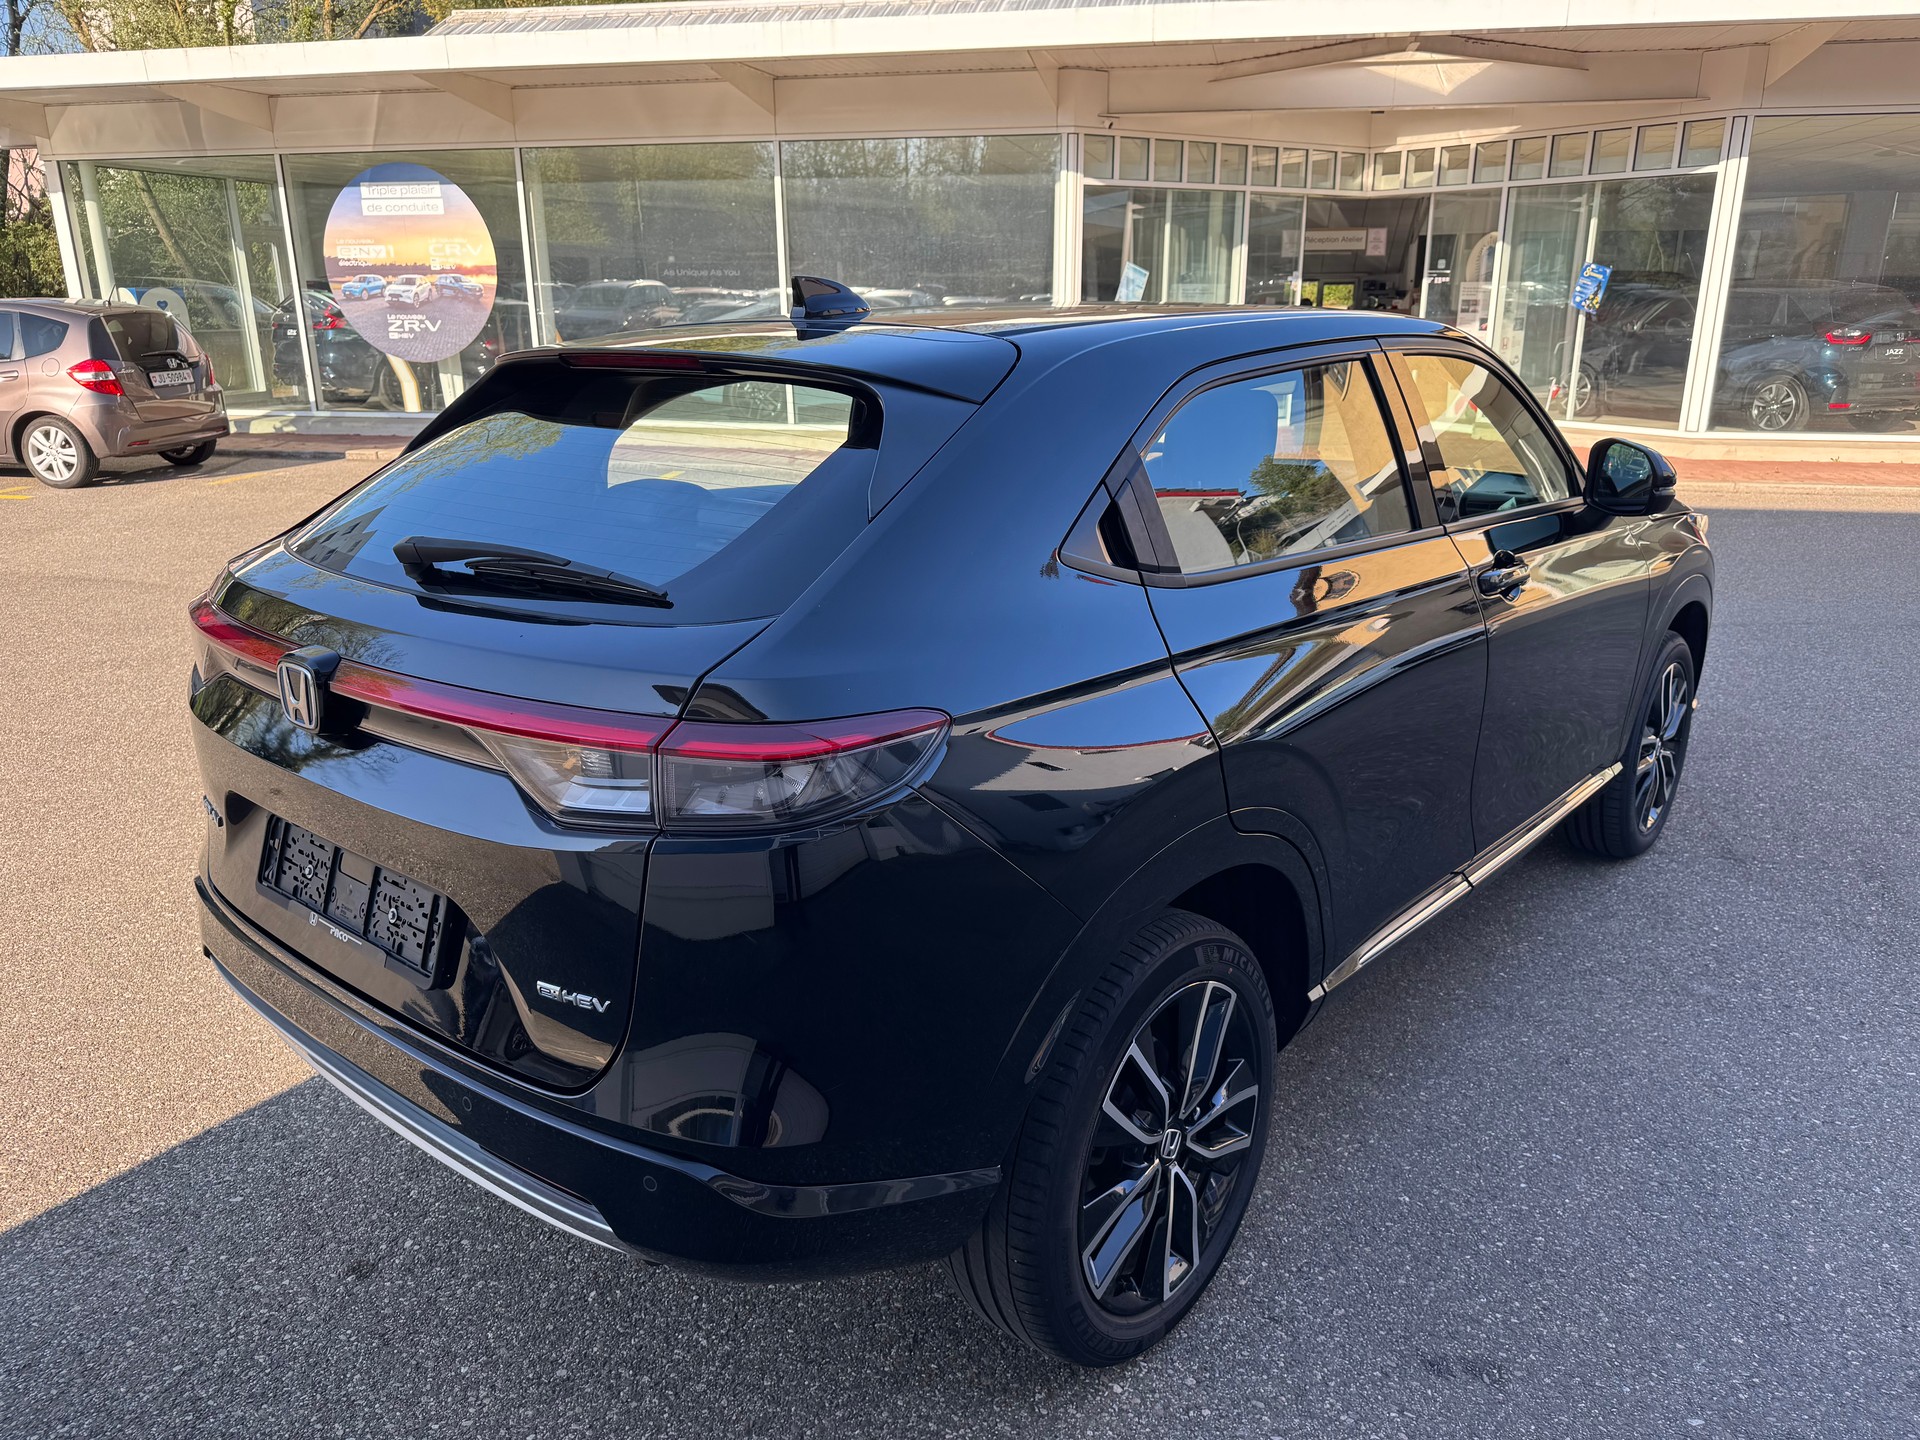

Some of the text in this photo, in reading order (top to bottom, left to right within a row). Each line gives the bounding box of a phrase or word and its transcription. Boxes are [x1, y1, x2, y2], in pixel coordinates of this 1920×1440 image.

[400, 185, 435, 197] plaisir
[366, 202, 439, 212] de conduite
[663, 267, 741, 277] As Unique As You
[1884, 347, 1904, 356] JAZZ
[1222, 946, 1272, 1014] MICHELIN
